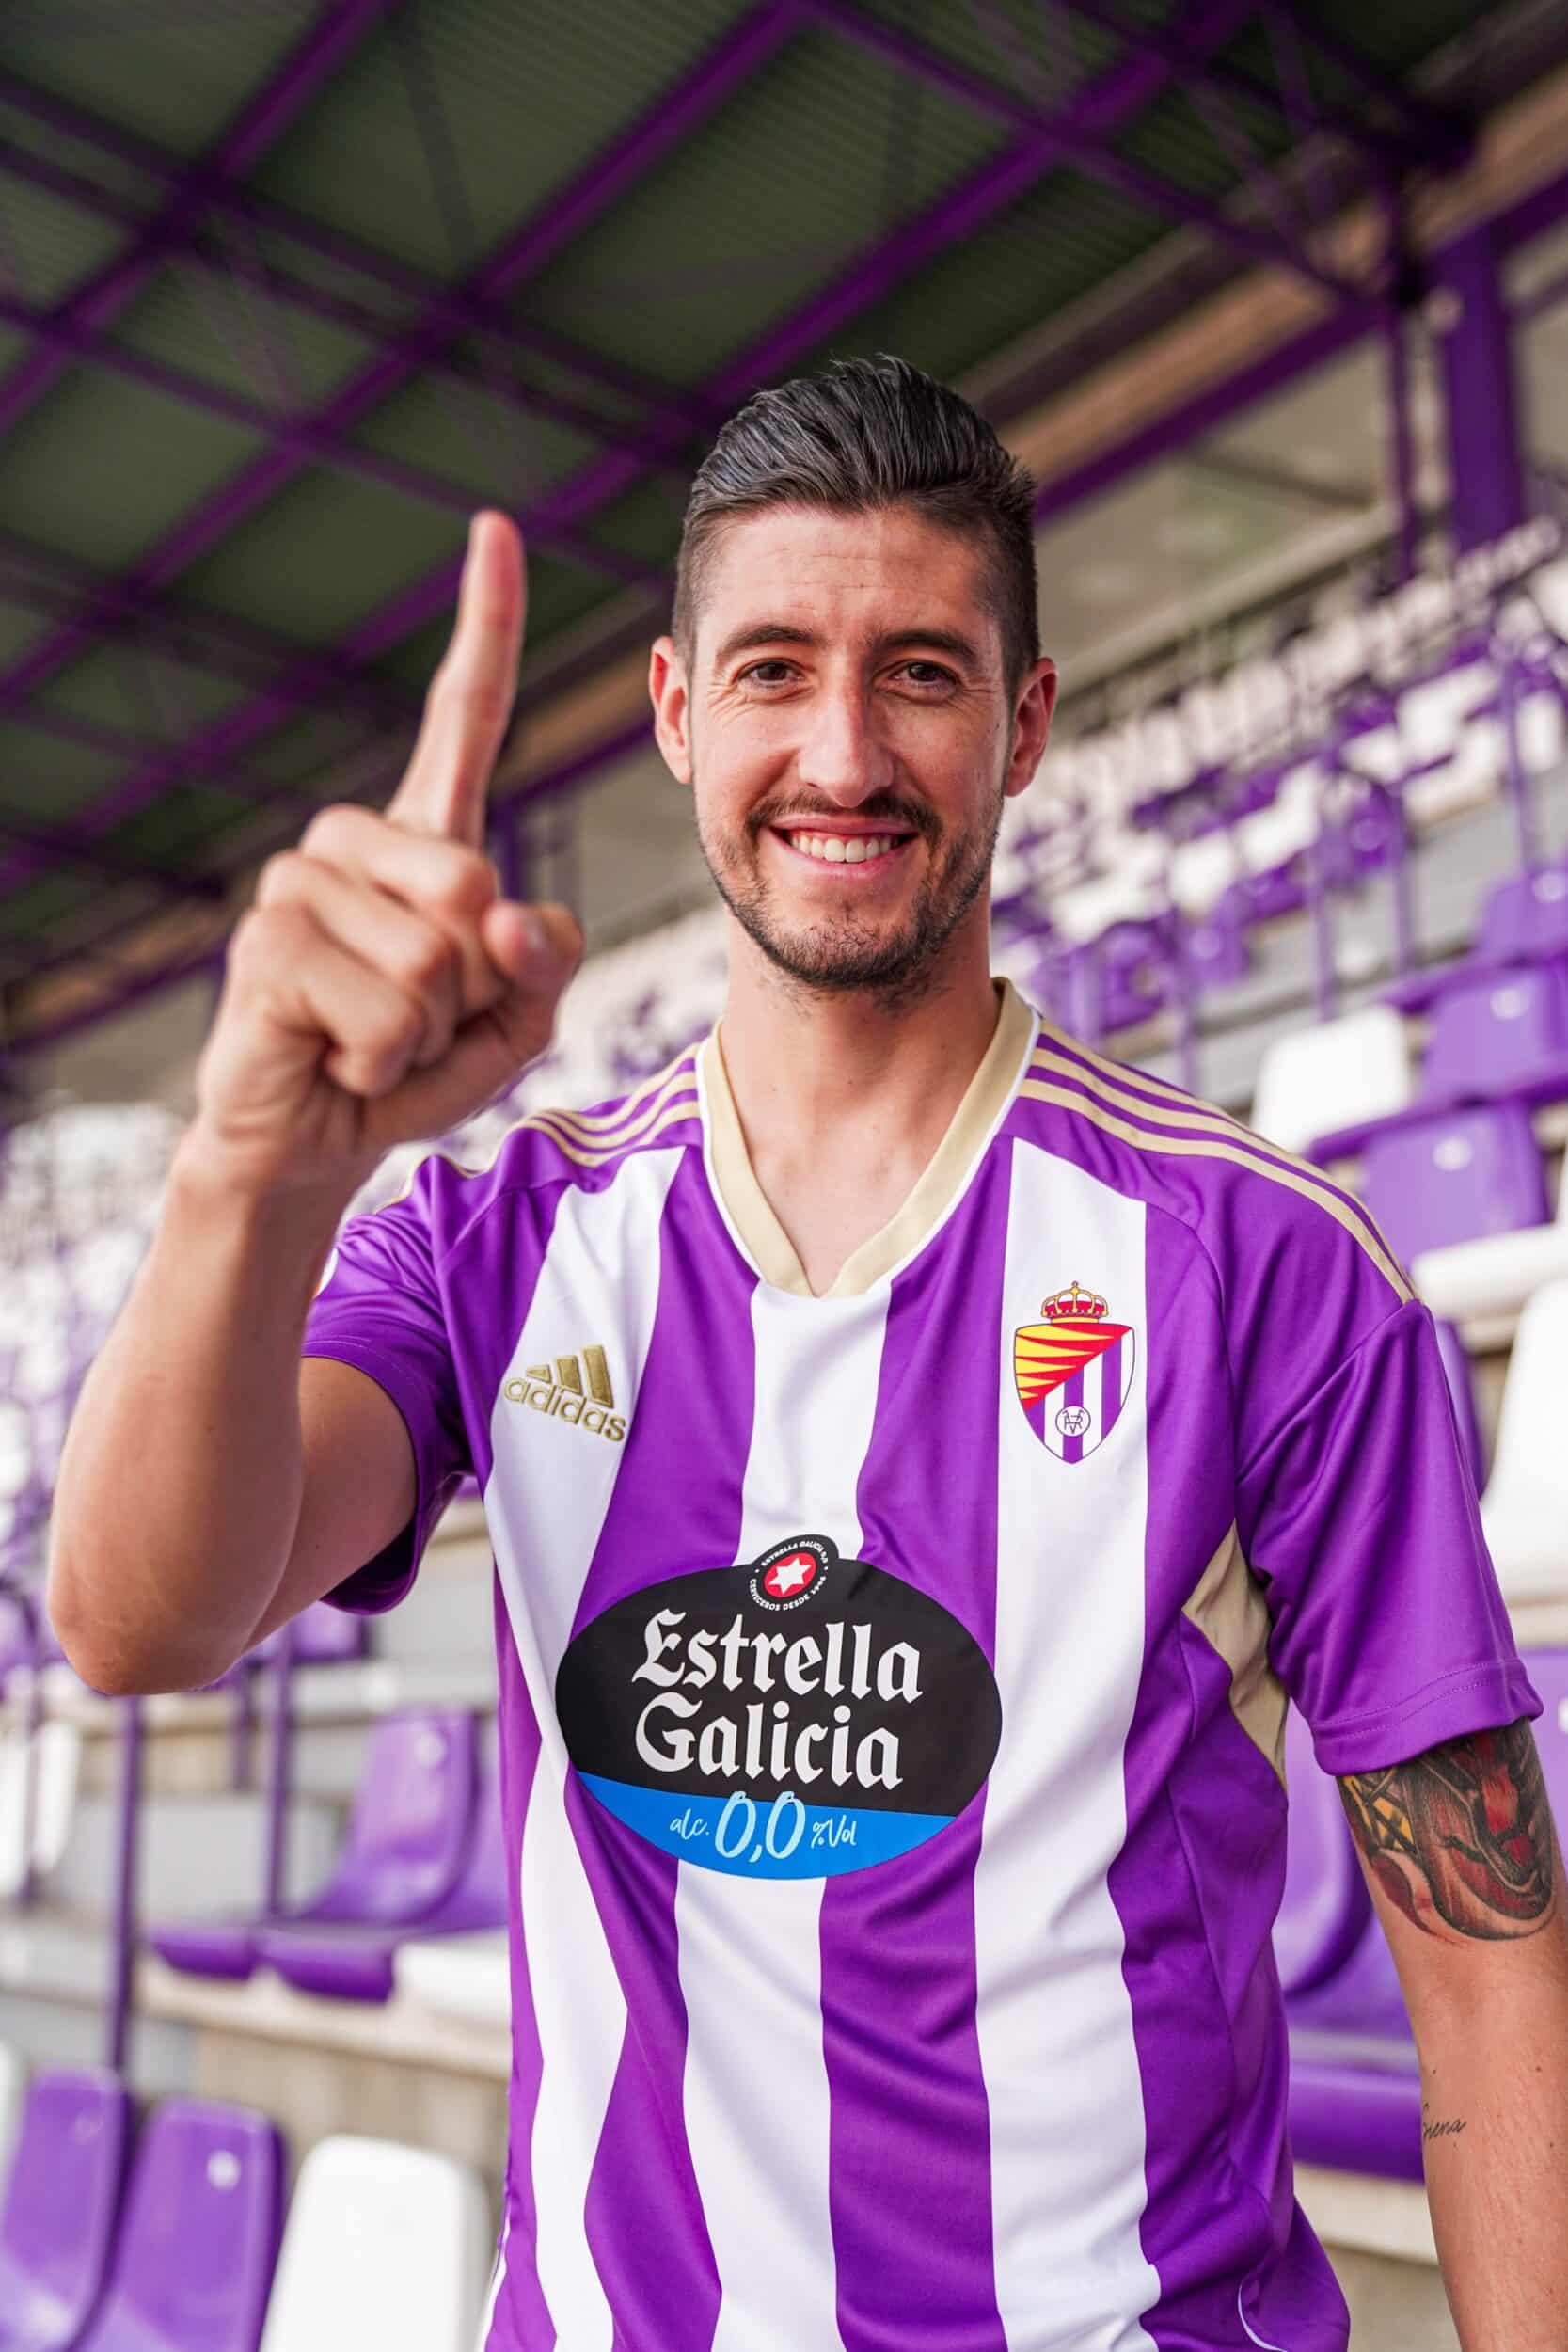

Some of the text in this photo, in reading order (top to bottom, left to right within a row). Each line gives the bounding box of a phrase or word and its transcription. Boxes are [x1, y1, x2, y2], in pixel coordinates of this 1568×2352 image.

[504, 1377, 626, 1442] adidas
[631, 1608, 923, 1704] Estrella
[635, 1692, 903, 1791] Galicia
[669, 1808, 710, 1840] alc.
[714, 1790, 806, 1863] 0,0
